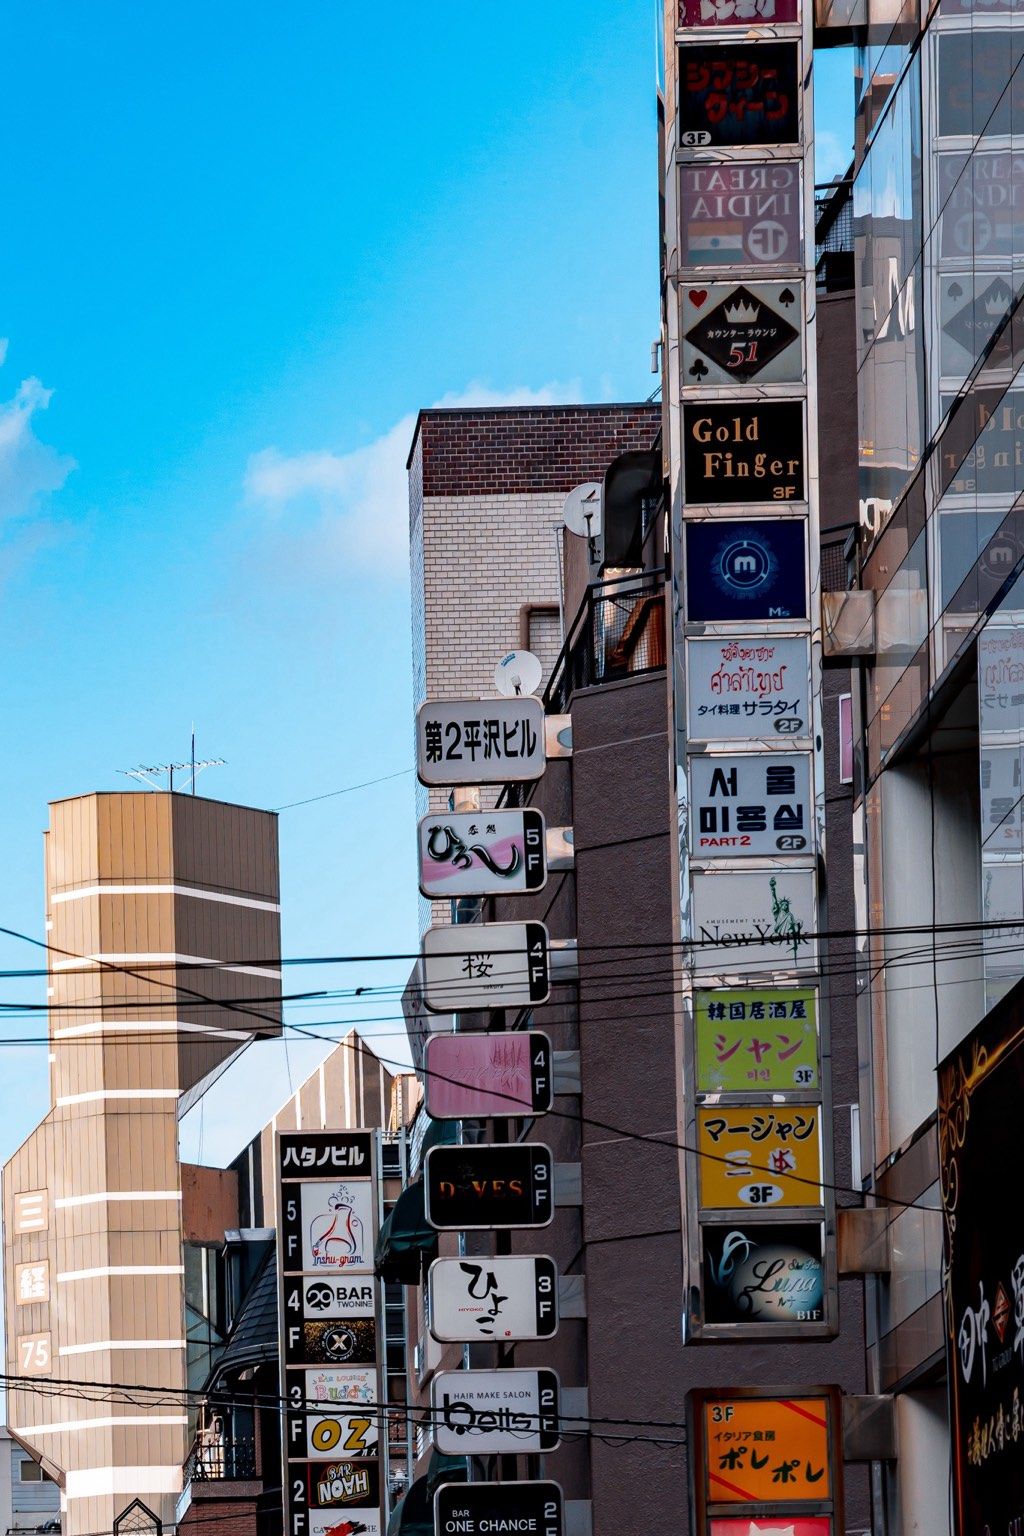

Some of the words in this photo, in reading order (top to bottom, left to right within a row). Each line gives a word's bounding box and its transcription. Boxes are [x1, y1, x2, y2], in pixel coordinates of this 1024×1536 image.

[686, 132, 707, 146] 3F
[706, 328, 744, 339] カウンター
[746, 328, 778, 339] ラウンジ
[727, 341, 759, 368] 51
[691, 417, 759, 443] Gold
[703, 452, 800, 479] Finger
[773, 487, 795, 499] 3F
[697, 703, 740, 716] タイ料理
[743, 698, 800, 716] サラタイ
[779, 719, 801, 733] 2F
[425, 718, 537, 764] 第2平沢ビル
[699, 805, 804, 834] 미용실
[427, 825, 521, 878] ひろし
[526, 829, 539, 871] 5F
[778, 837, 802, 850] 2F
[462, 954, 493, 980] 桜
[707, 1001, 808, 1021] 韓国居酒屋
[713, 1034, 804, 1064] シャン
[533, 1051, 547, 1095] 4F
[794, 1067, 814, 1083] 3F
[703, 1114, 817, 1142] マージャン
[283, 1146, 365, 1167] ハタノビル
[439, 1180, 524, 1200] DVES
[534, 1164, 548, 1207] 3F
[749, 1185, 773, 1203] 3F
[750, 1257, 818, 1294] Luna
[337, 1286, 372, 1300] BAR
[538, 1276, 552, 1318] 3F
[796, 1310, 821, 1321] B1F
[453, 1392, 476, 1401] HAIR
[477, 1391, 502, 1400] MAKE
[504, 1390, 532, 1400] SALON
[711, 1405, 734, 1422] 3F
[312, 1419, 371, 1452] OZ
[719, 1447, 769, 1470] ポレ
[772, 1459, 824, 1483] ポレ
[451, 1509, 471, 1518] BAR
[445, 1520, 474, 1533] ONE
[479, 1518, 537, 1532] CHANCE
